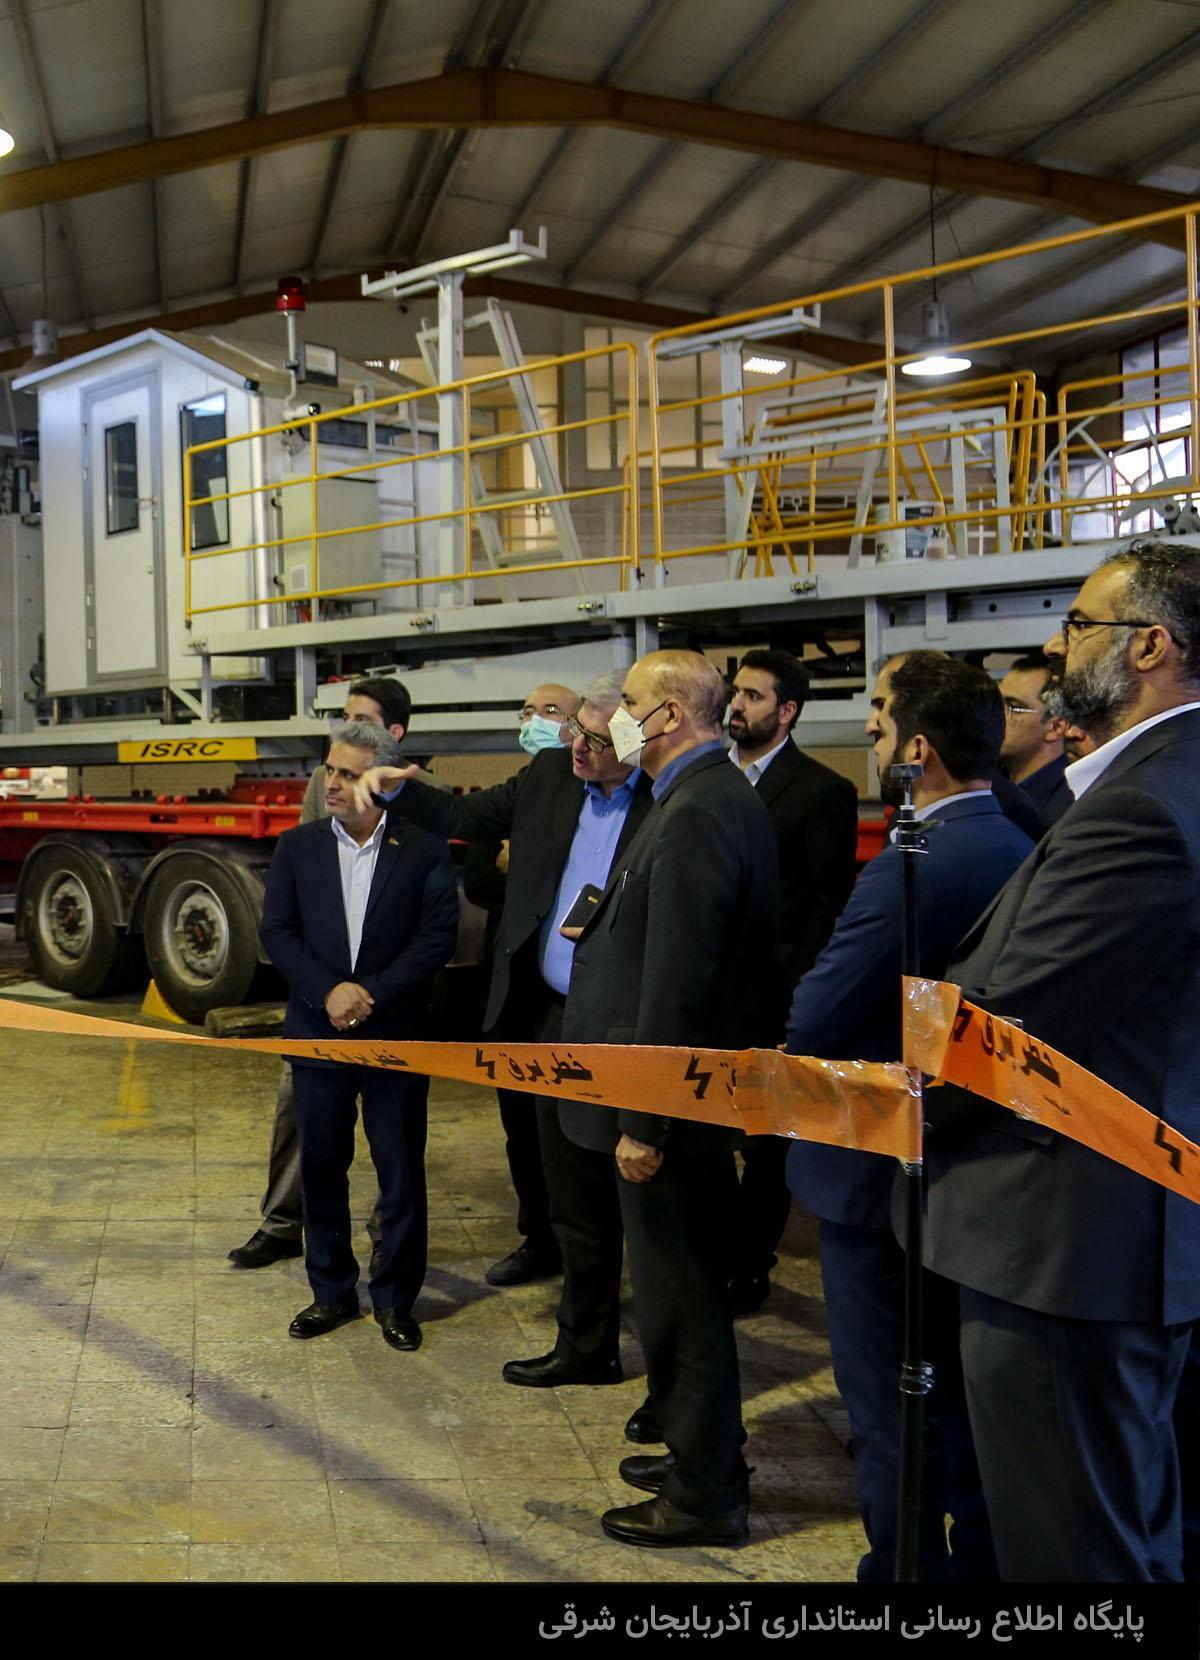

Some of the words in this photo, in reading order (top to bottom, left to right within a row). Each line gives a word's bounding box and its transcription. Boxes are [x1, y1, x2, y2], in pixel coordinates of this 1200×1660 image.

[140, 740, 224, 758] ISRC
[499, 1052, 550, 1085] برق
[550, 1051, 594, 1085] خطر
